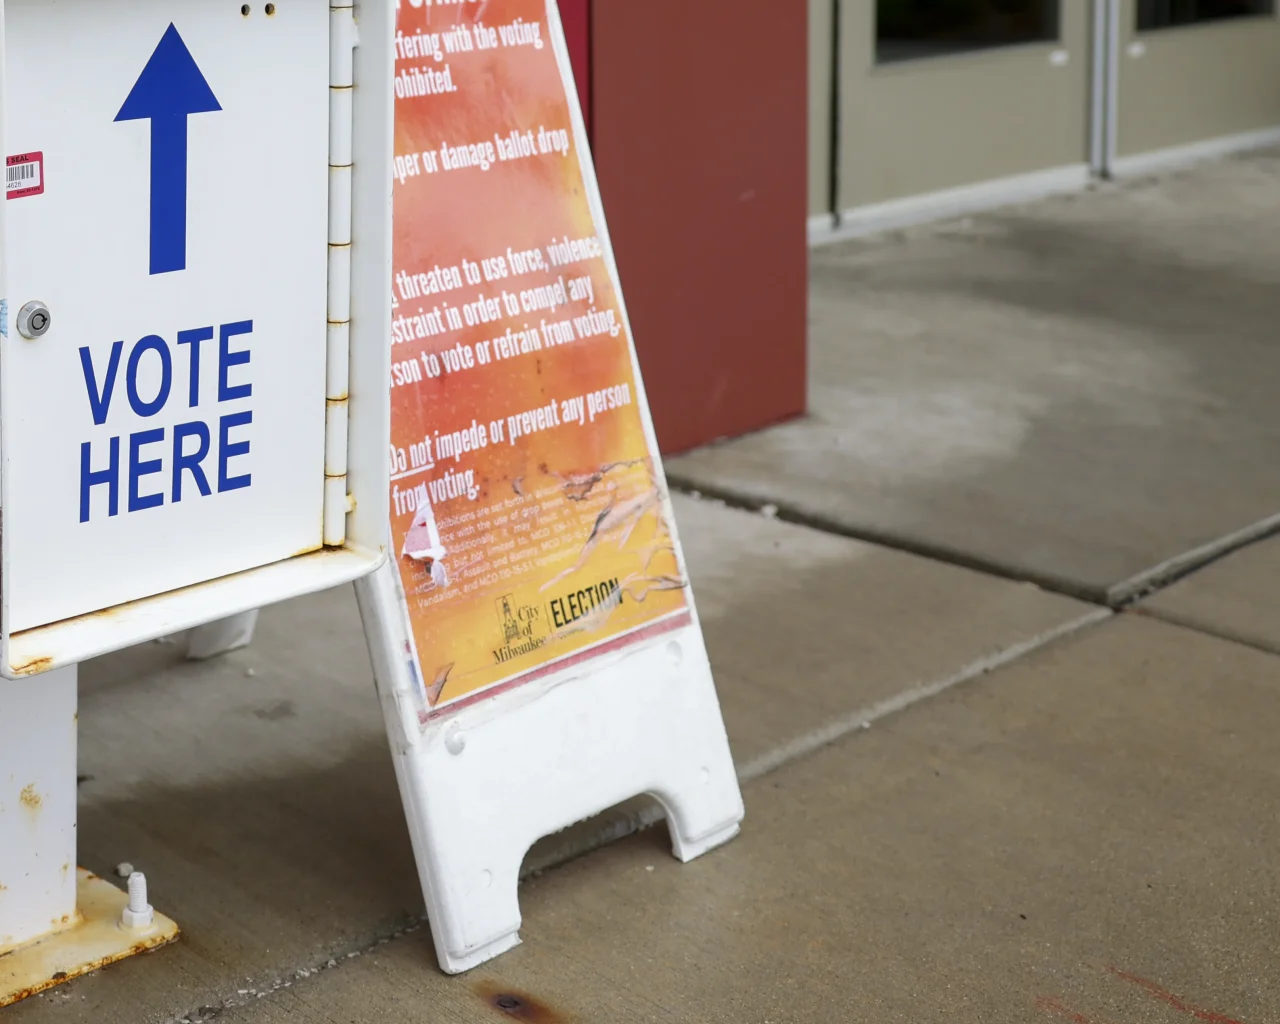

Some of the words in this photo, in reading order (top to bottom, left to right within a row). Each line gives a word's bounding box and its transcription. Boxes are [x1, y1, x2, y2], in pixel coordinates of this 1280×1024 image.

[442, 23, 473, 53] with
[473, 21, 498, 50] the
[498, 17, 544, 49] voting
[394, 63, 457, 99] ohibited.
[10, 154, 29, 164] SEAL
[422, 149, 438, 174] or
[440, 141, 496, 171] damage
[494, 129, 538, 161] ballot
[537, 125, 569, 157] drop
[396, 264, 463, 301] threaten
[462, 258, 482, 286] to
[481, 255, 509, 282] use
[506, 246, 549, 273] force,
[442, 301, 464, 331] in
[463, 293, 502, 327] order
[502, 290, 521, 317] to
[520, 275, 568, 314] compel
[568, 275, 595, 305] any
[421, 350, 441, 379] to
[440, 342, 475, 374] vote
[475, 339, 491, 365] or
[492, 323, 542, 360] refrain
[540, 318, 575, 349] from
[573, 305, 621, 338] voting.
[78, 319, 253, 426] VOTE
[409, 434, 434, 469] not
[434, 419, 488, 462] impede
[489, 418, 504, 444] or
[507, 398, 560, 447] prevent
[561, 396, 585, 426] any
[586, 382, 631, 423] person
[79, 410, 253, 524] HERE
[428, 467, 480, 500] voting.
[457, 524, 475, 537] with
[477, 520, 491, 531] the
[494, 516, 508, 526] use
[521, 505, 540, 518] drop
[476, 507, 490, 518] are
[513, 522, 531, 533] may
[463, 581, 479, 593] and
[550, 577, 624, 628] ELECTION
[518, 605, 540, 621] City
[522, 620, 532, 637] of
